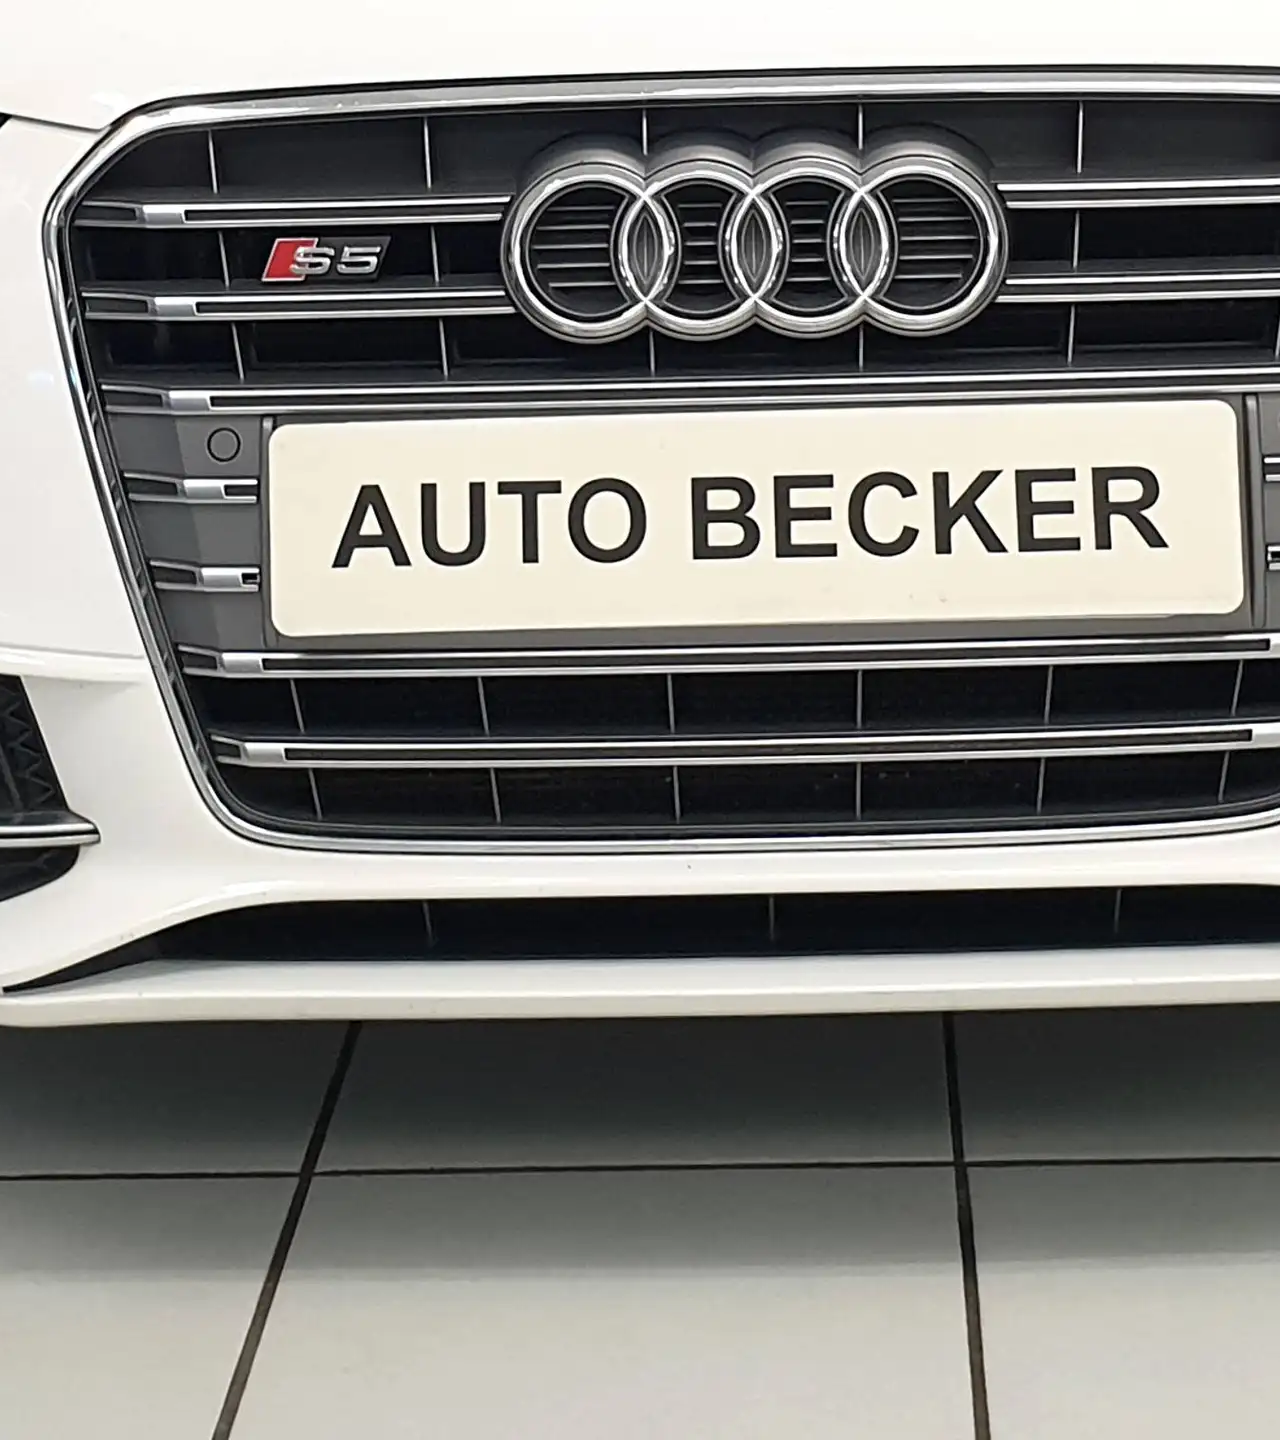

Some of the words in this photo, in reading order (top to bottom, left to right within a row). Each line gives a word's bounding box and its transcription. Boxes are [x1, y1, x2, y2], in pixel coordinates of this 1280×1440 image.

[289, 246, 381, 275] S5
[331, 477, 647, 569] AUTO
[690, 466, 1169, 560] BECKER
